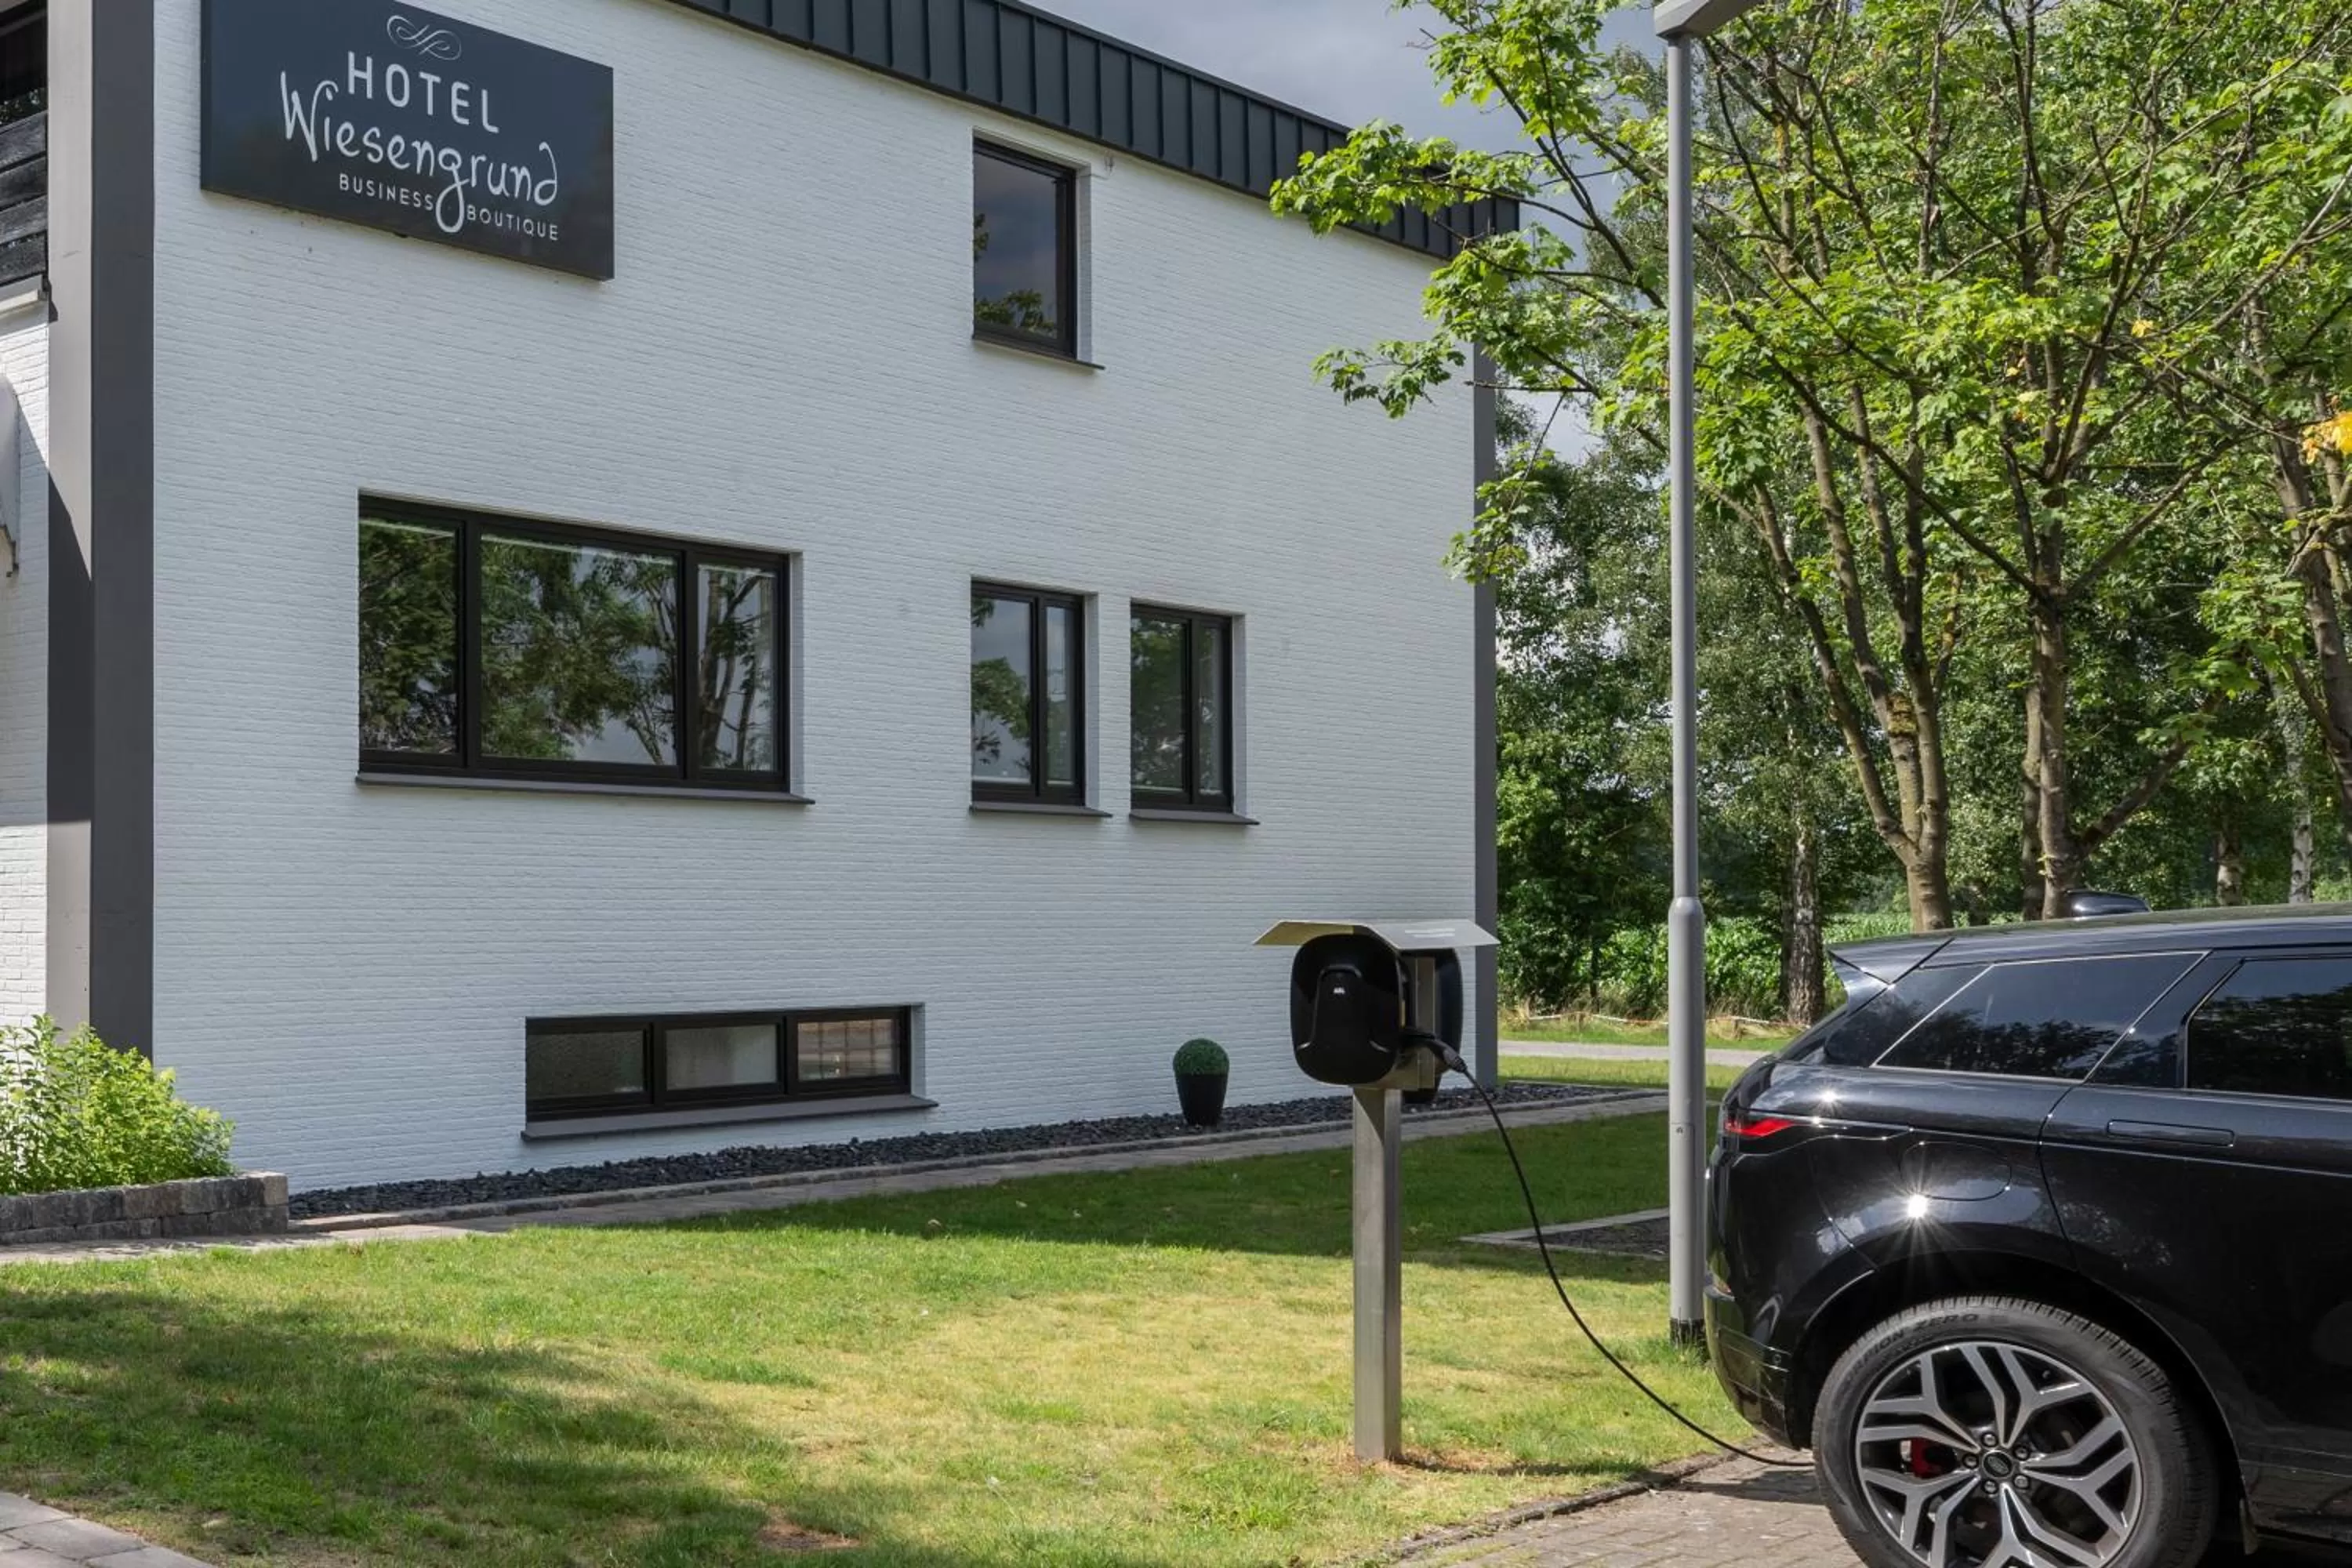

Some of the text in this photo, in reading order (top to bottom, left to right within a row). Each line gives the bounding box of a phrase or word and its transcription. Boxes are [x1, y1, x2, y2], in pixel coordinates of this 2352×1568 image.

[347, 51, 499, 134] HOTEL
[280, 71, 558, 234] Wiesengrund
[339, 172, 559, 241] BUSINESS BOUTIQUE
